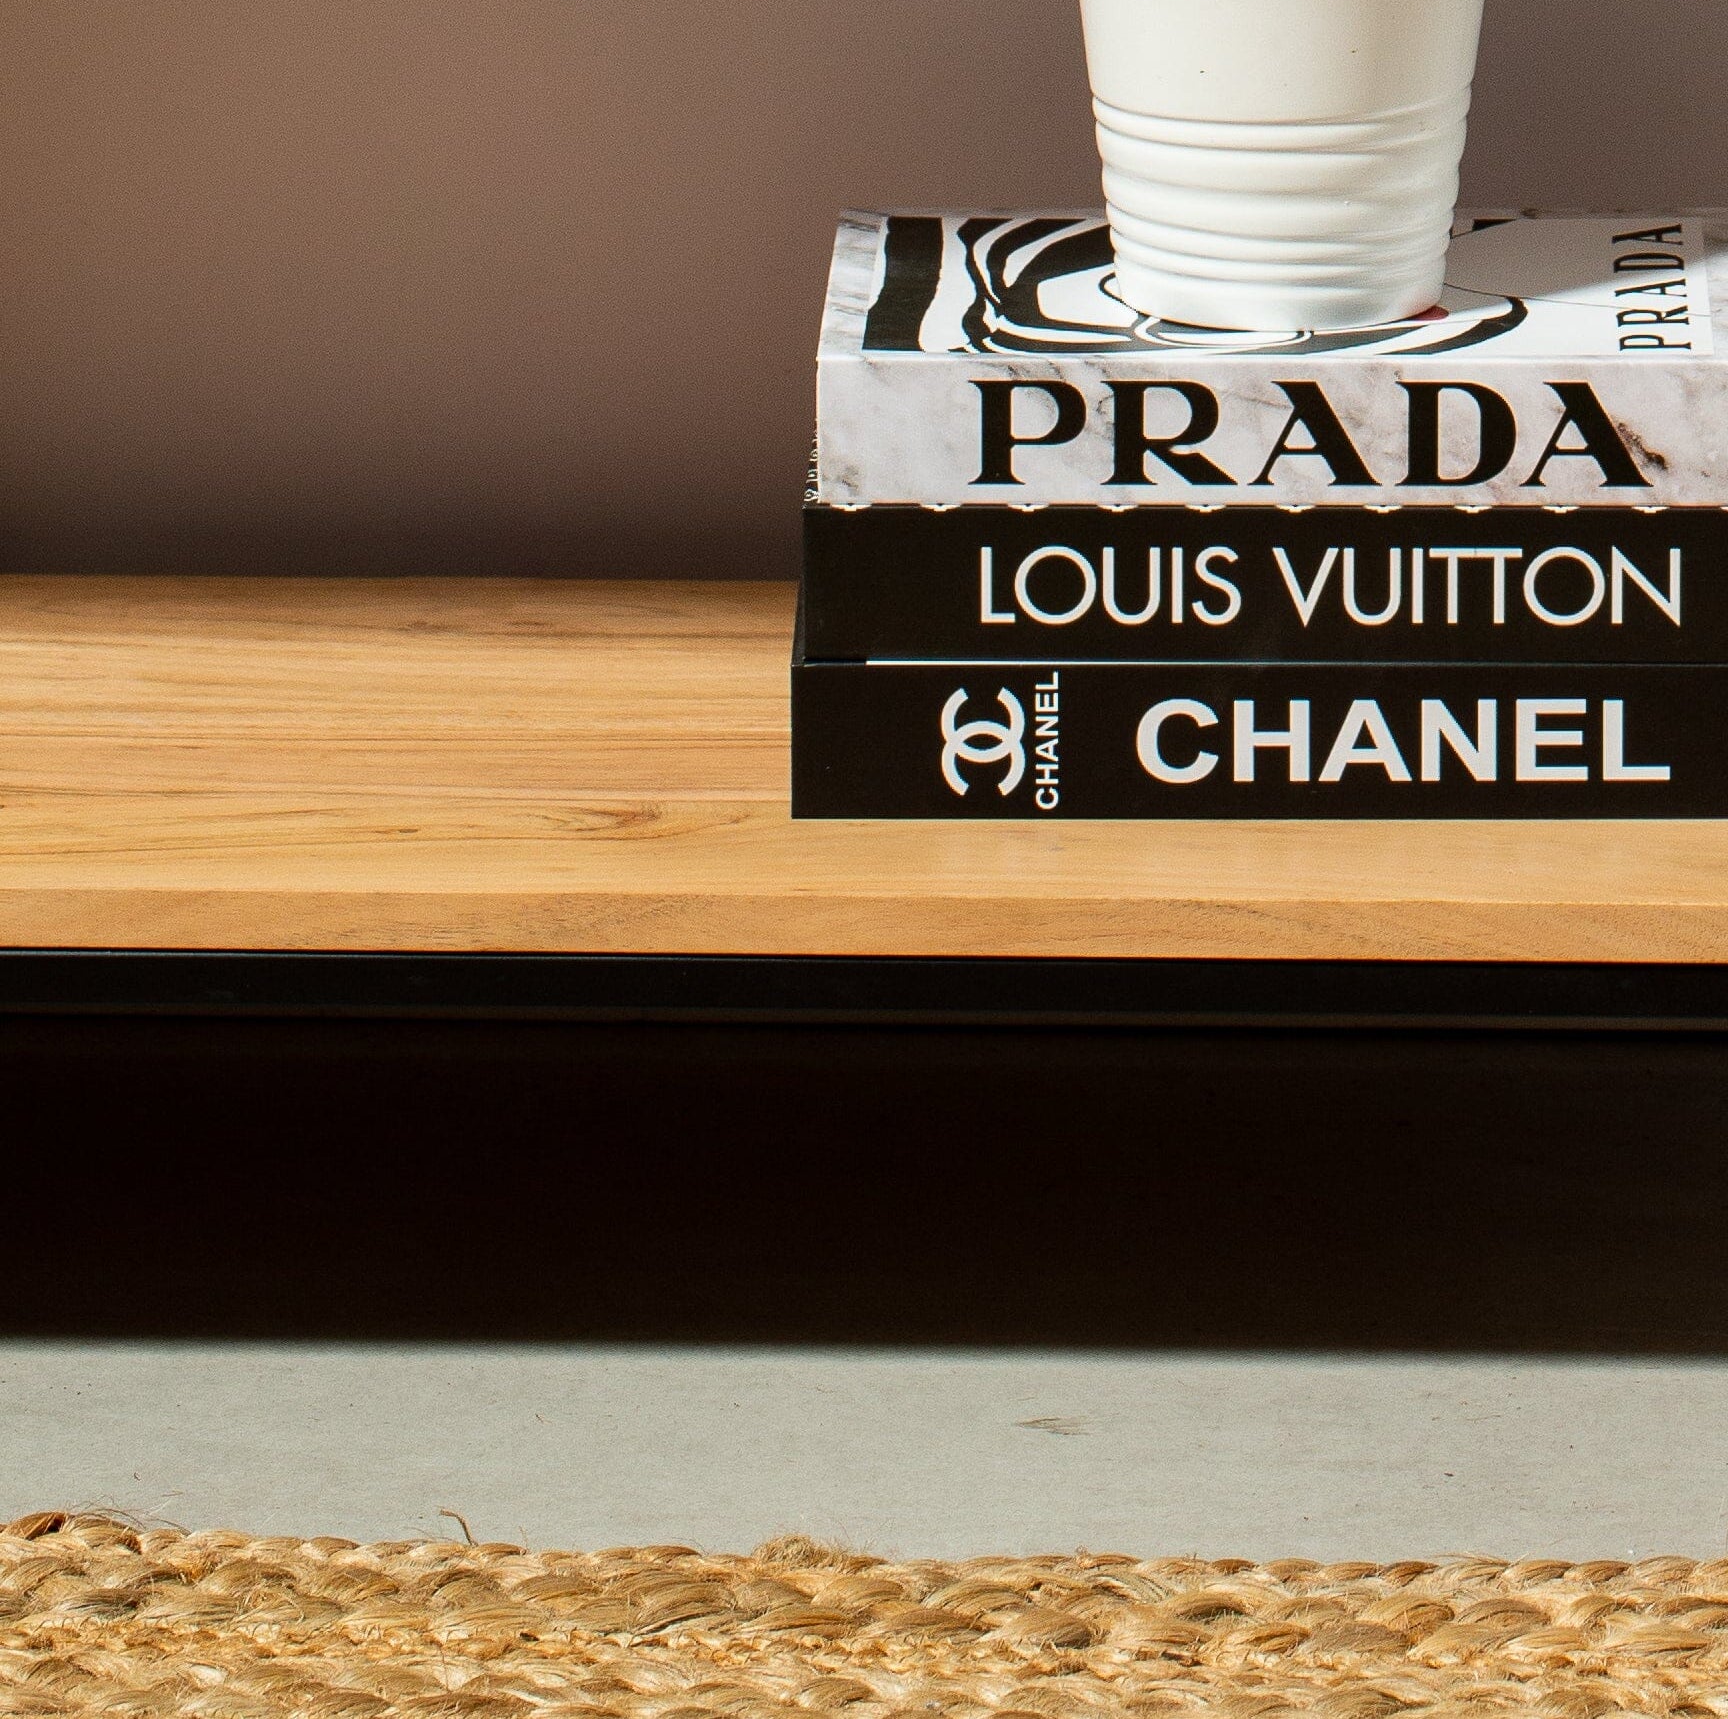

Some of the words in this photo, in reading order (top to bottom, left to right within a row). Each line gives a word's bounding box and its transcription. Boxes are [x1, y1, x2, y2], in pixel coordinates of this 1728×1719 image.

[1611, 222, 1692, 351] PRADA
[968, 380, 1654, 488] PRADA
[979, 545, 1242, 626] LOUIS
[1271, 545, 1682, 627] VUITTON
[1034, 670, 1060, 811] CHANEL
[1134, 697, 1672, 784] CHANEL
